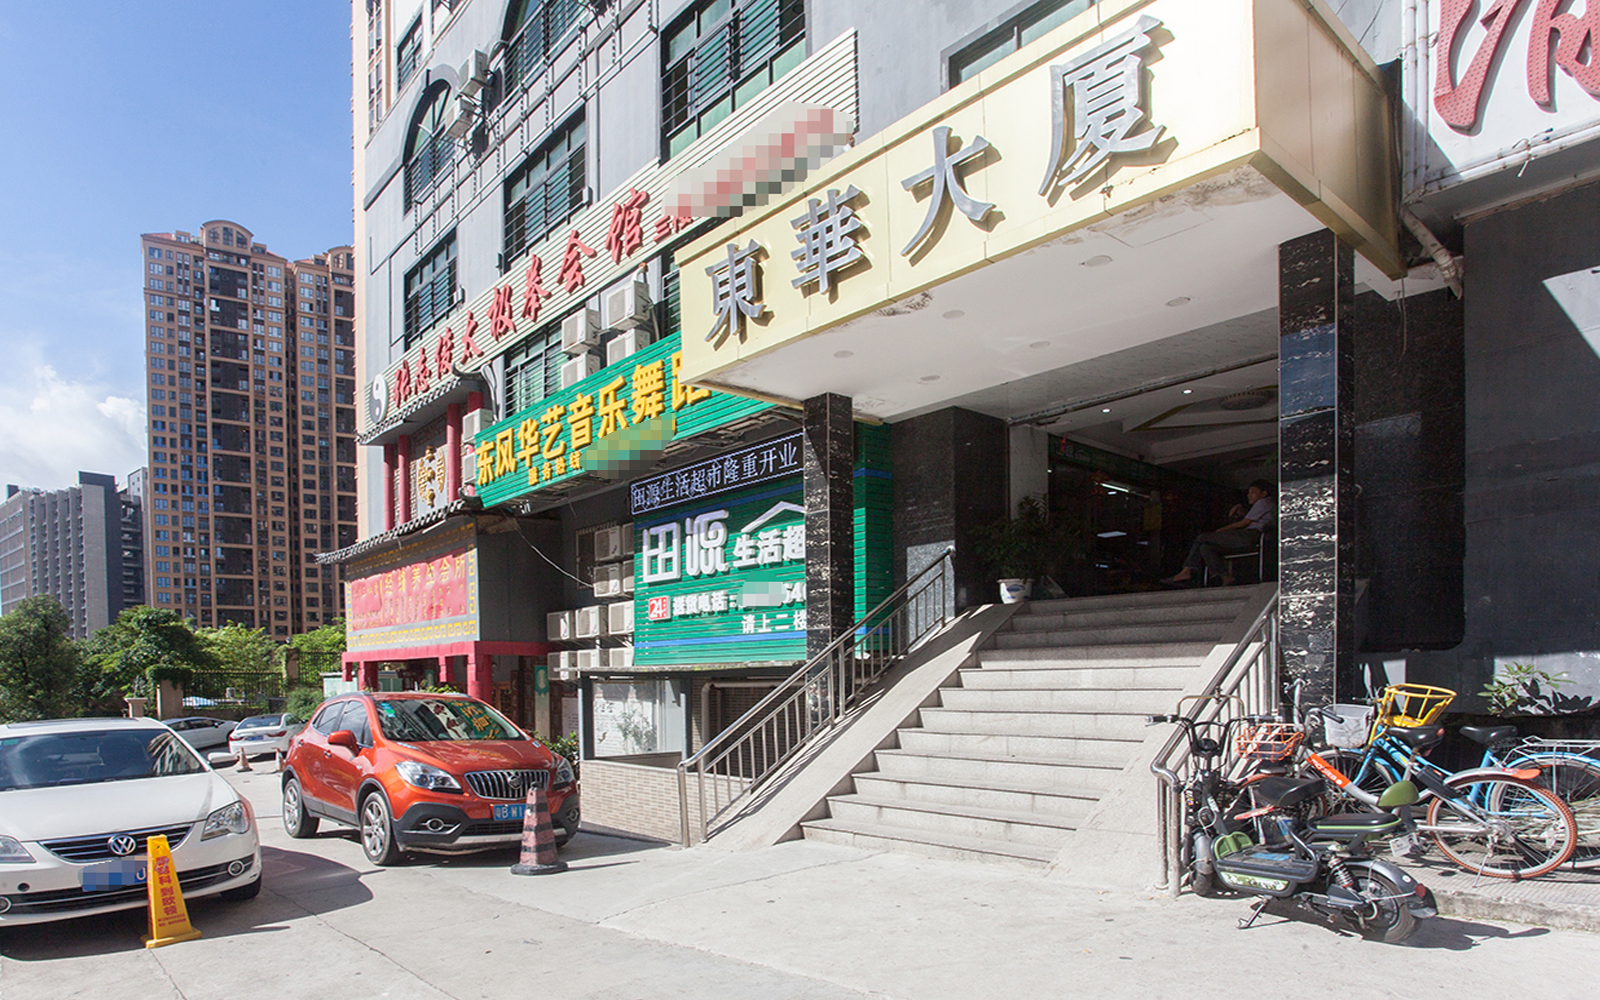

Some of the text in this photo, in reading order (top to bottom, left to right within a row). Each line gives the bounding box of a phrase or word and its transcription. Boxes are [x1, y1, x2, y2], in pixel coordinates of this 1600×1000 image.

[704, 14, 1166, 350] 東華大厦
[632, 442, 798, 508] 田源生活超市隆重开业
